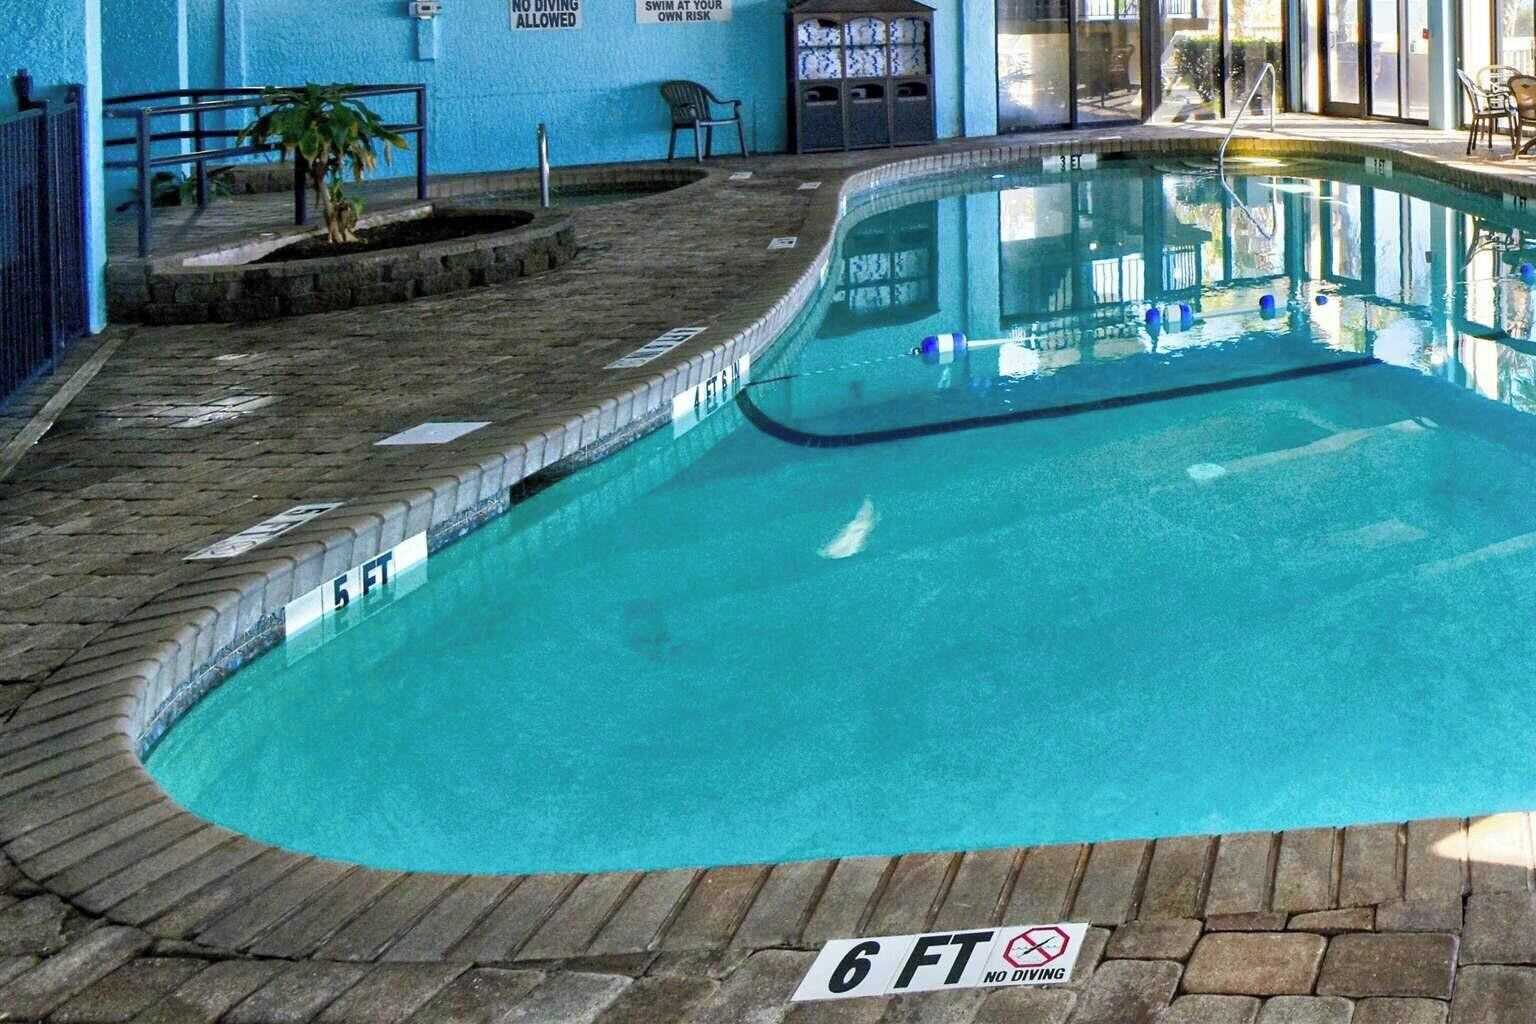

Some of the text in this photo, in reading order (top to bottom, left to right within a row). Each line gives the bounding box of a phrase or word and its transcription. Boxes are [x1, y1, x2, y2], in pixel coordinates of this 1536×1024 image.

[645, 0, 723, 11] SWIM AT YOUR
[516, 12, 577, 29] ALLOWED
[658, 10, 711, 22] OWN RISK
[334, 551, 393, 612] 5 FT
[828, 931, 995, 994] 6 FT
[983, 967, 1066, 984] NO DIVING
